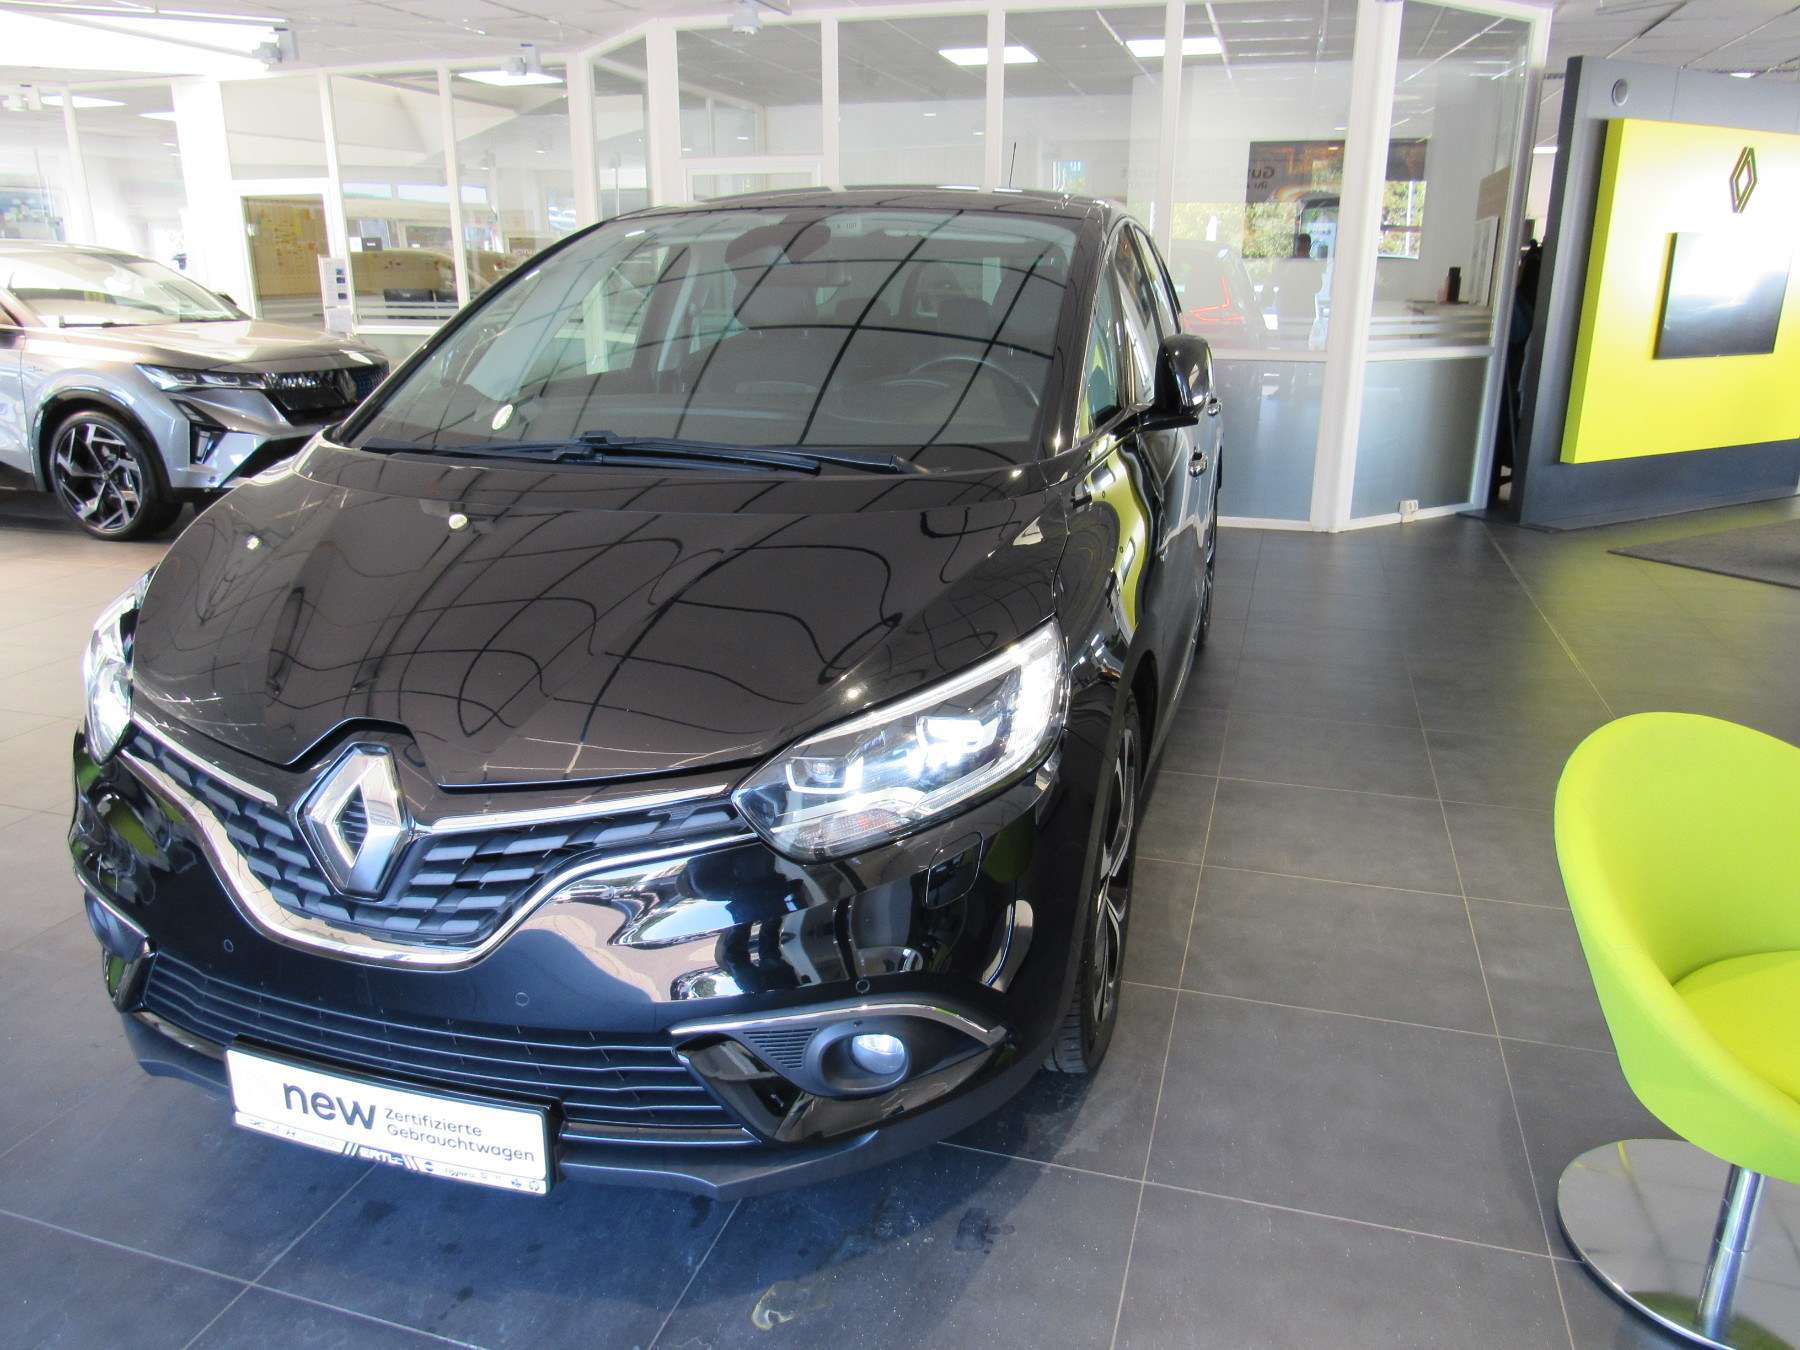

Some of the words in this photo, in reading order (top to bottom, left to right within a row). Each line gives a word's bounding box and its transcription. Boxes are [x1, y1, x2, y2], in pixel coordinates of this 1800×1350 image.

[283, 1083, 376, 1130] new
[385, 1108, 482, 1137] Zertifizierte
[387, 1123, 535, 1162] Gebrauchtwagen
